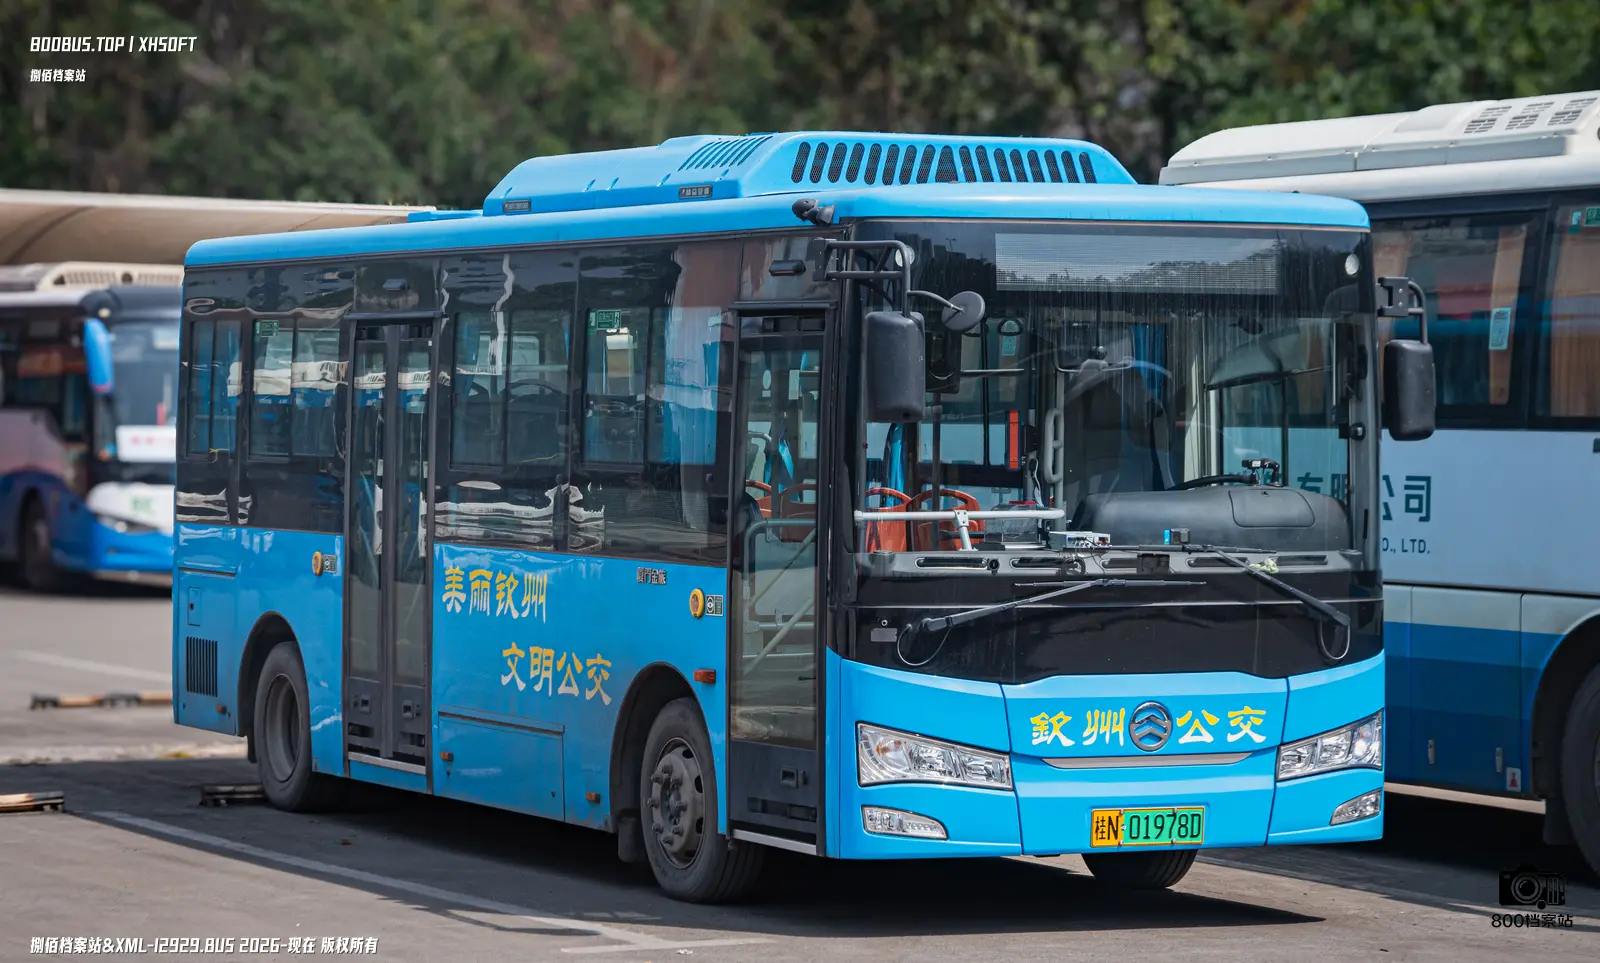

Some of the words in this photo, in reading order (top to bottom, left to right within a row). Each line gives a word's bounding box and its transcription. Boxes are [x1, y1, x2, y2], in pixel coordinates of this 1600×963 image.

[1401, 538, 1431, 554] LTD.
[501, 641, 612, 706] 文明公交
[1176, 706, 1266, 744] 公交
